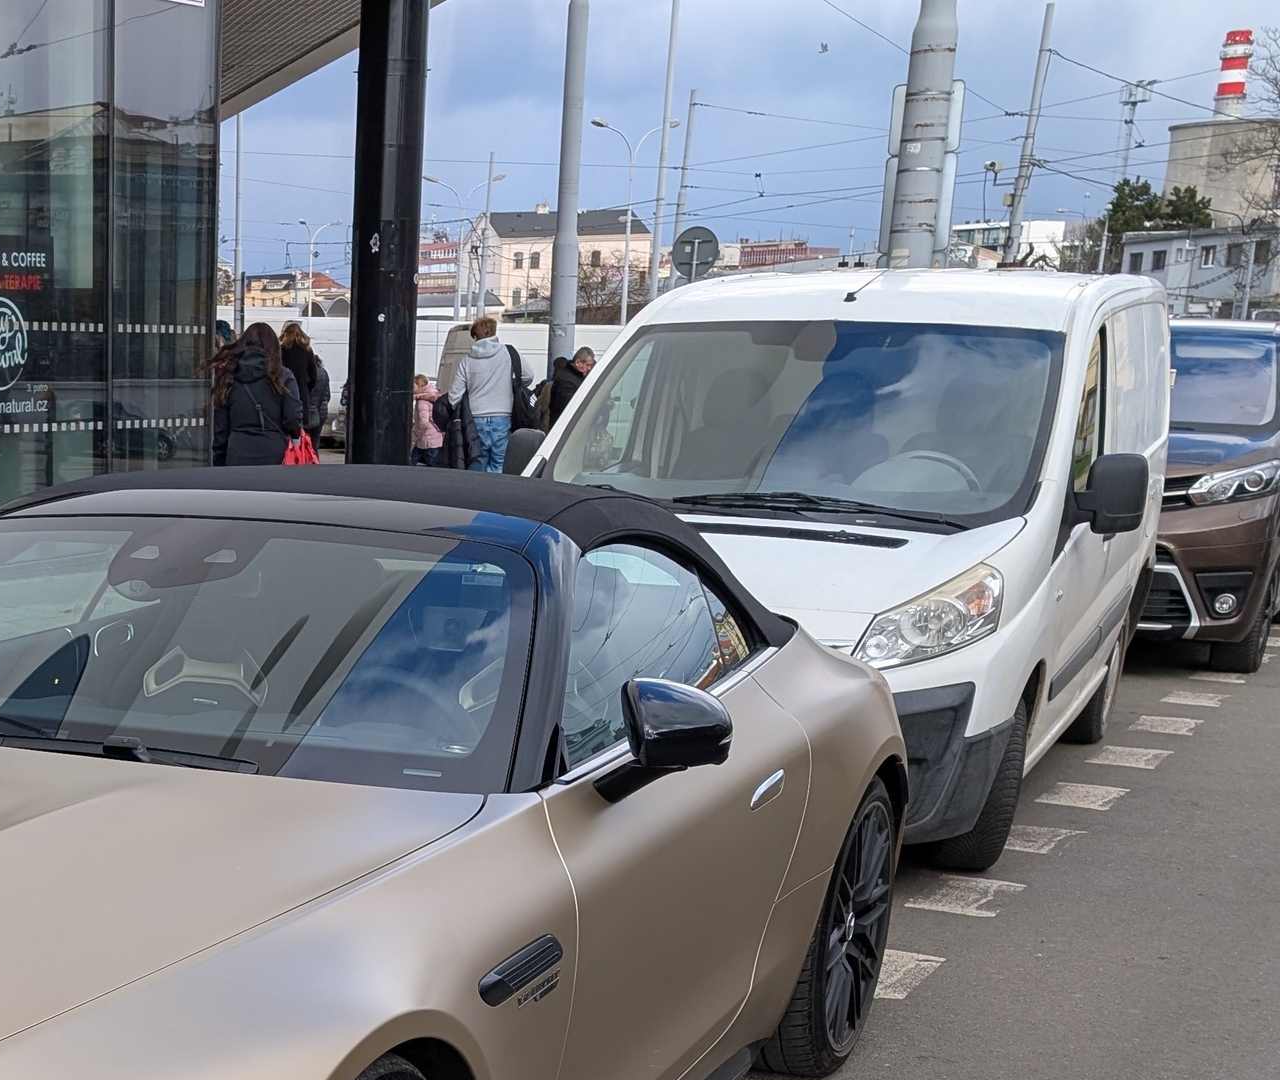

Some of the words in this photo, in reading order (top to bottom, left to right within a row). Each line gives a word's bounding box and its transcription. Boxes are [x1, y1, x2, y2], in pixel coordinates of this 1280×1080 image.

[2, 252, 9, 266] &
[10, 252, 46, 267] COFFEE
[4, 274, 42, 290] TERAPIE
[34, 383, 48, 394] patro
